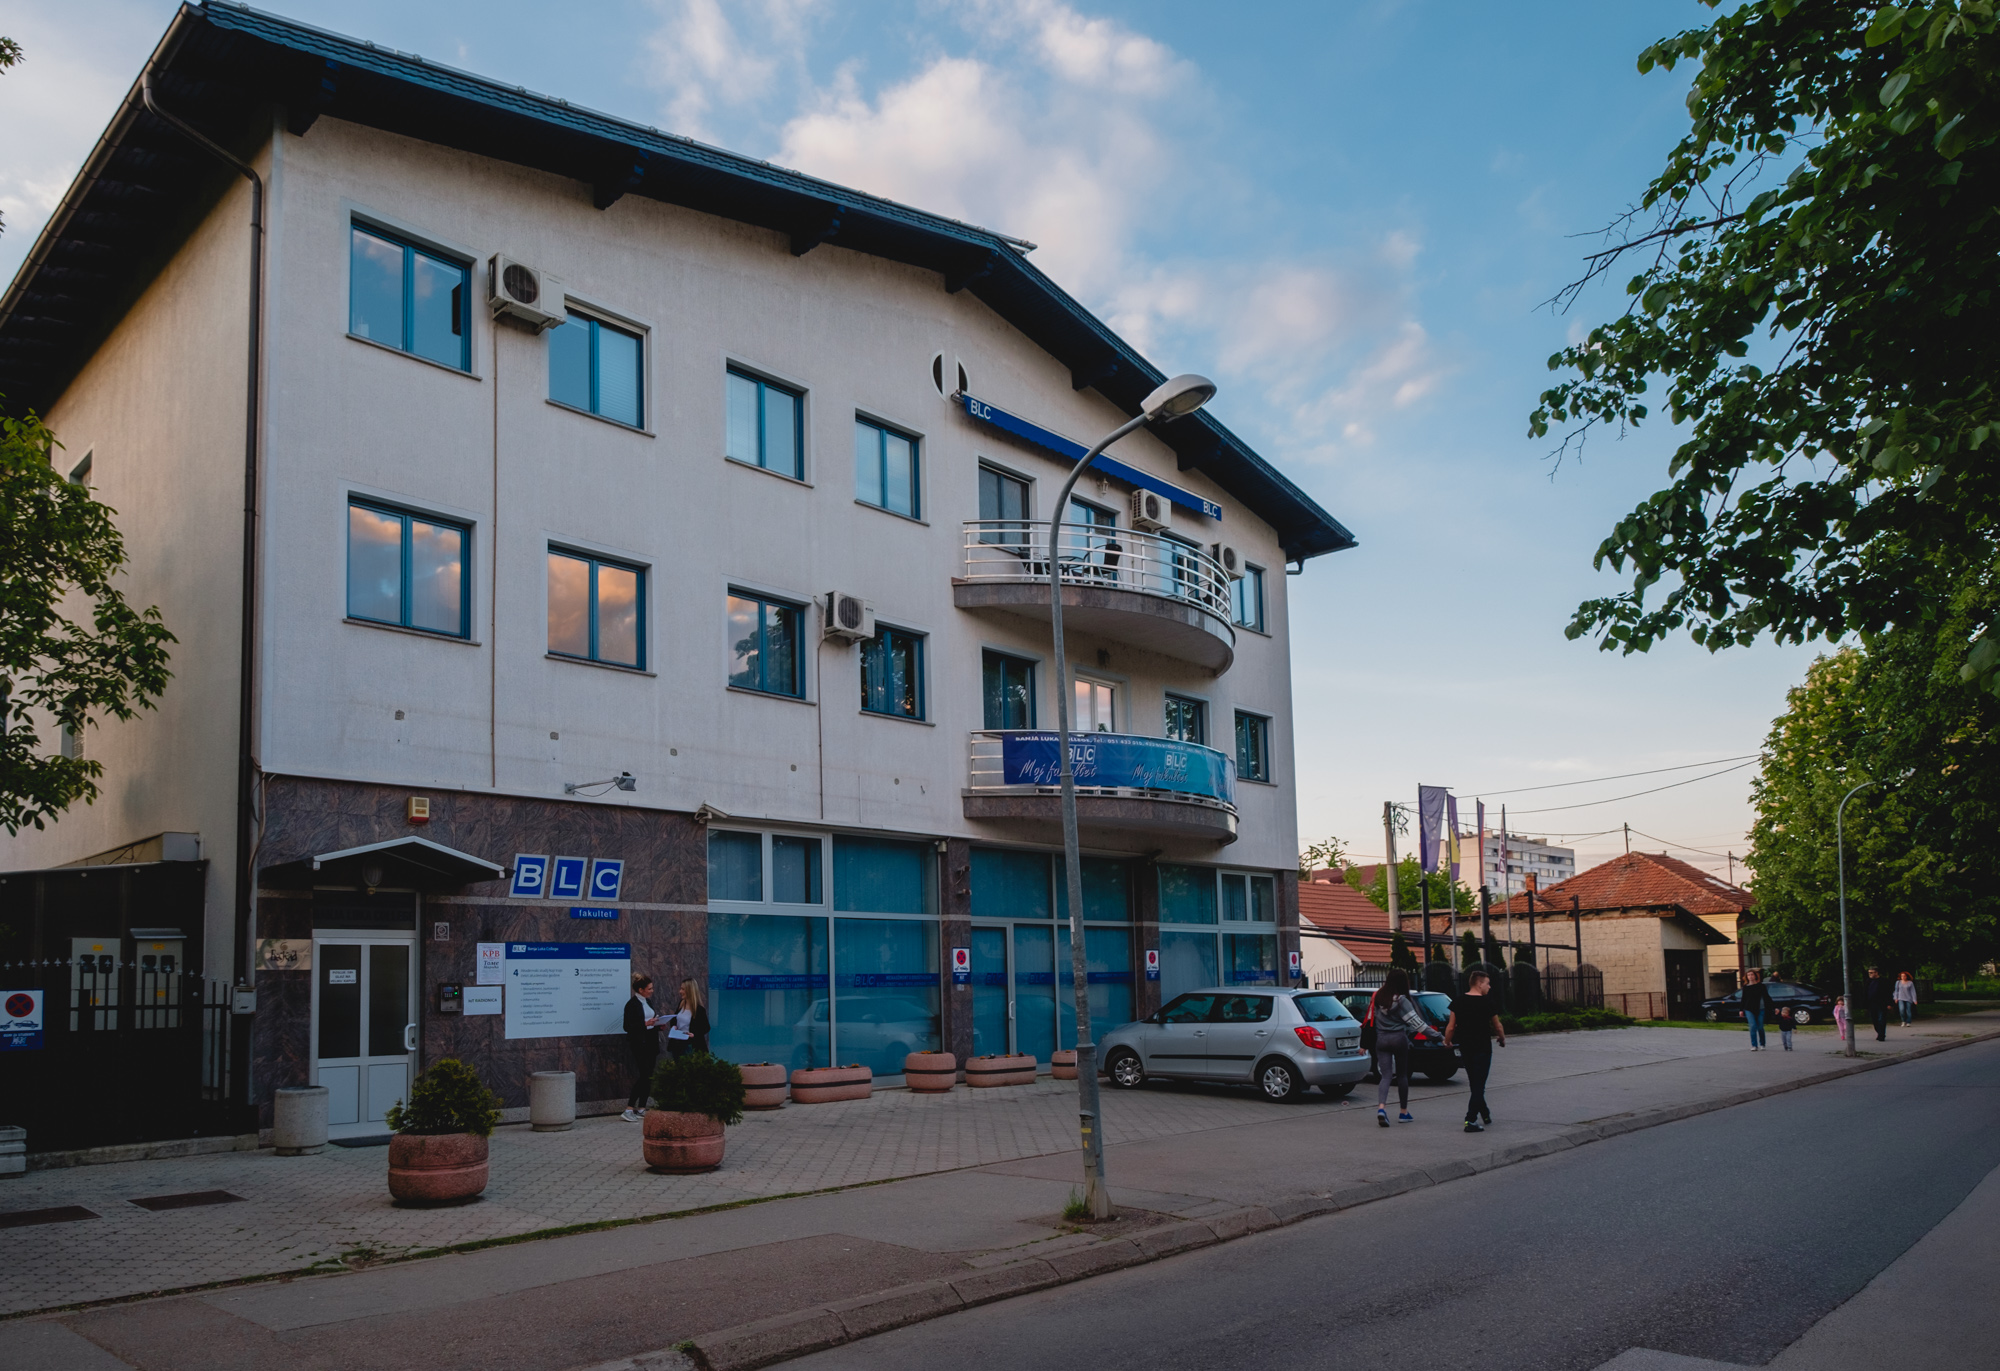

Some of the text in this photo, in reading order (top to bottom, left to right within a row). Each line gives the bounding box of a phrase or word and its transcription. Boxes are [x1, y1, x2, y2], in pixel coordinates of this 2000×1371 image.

[971, 399, 991, 420] BLC
[1203, 501, 1218, 517] BLC
[1166, 754, 1187, 768] BLC
[1018, 758, 1045, 782] Moj
[1131, 763, 1154, 786] Moj
[517, 863, 620, 892] BLC
[579, 909, 613, 918] fakultet
[513, 968, 519, 977] 4
[574, 968, 580, 977] 3
[728, 976, 751, 988] BLC
[855, 975, 875, 986] BLC
